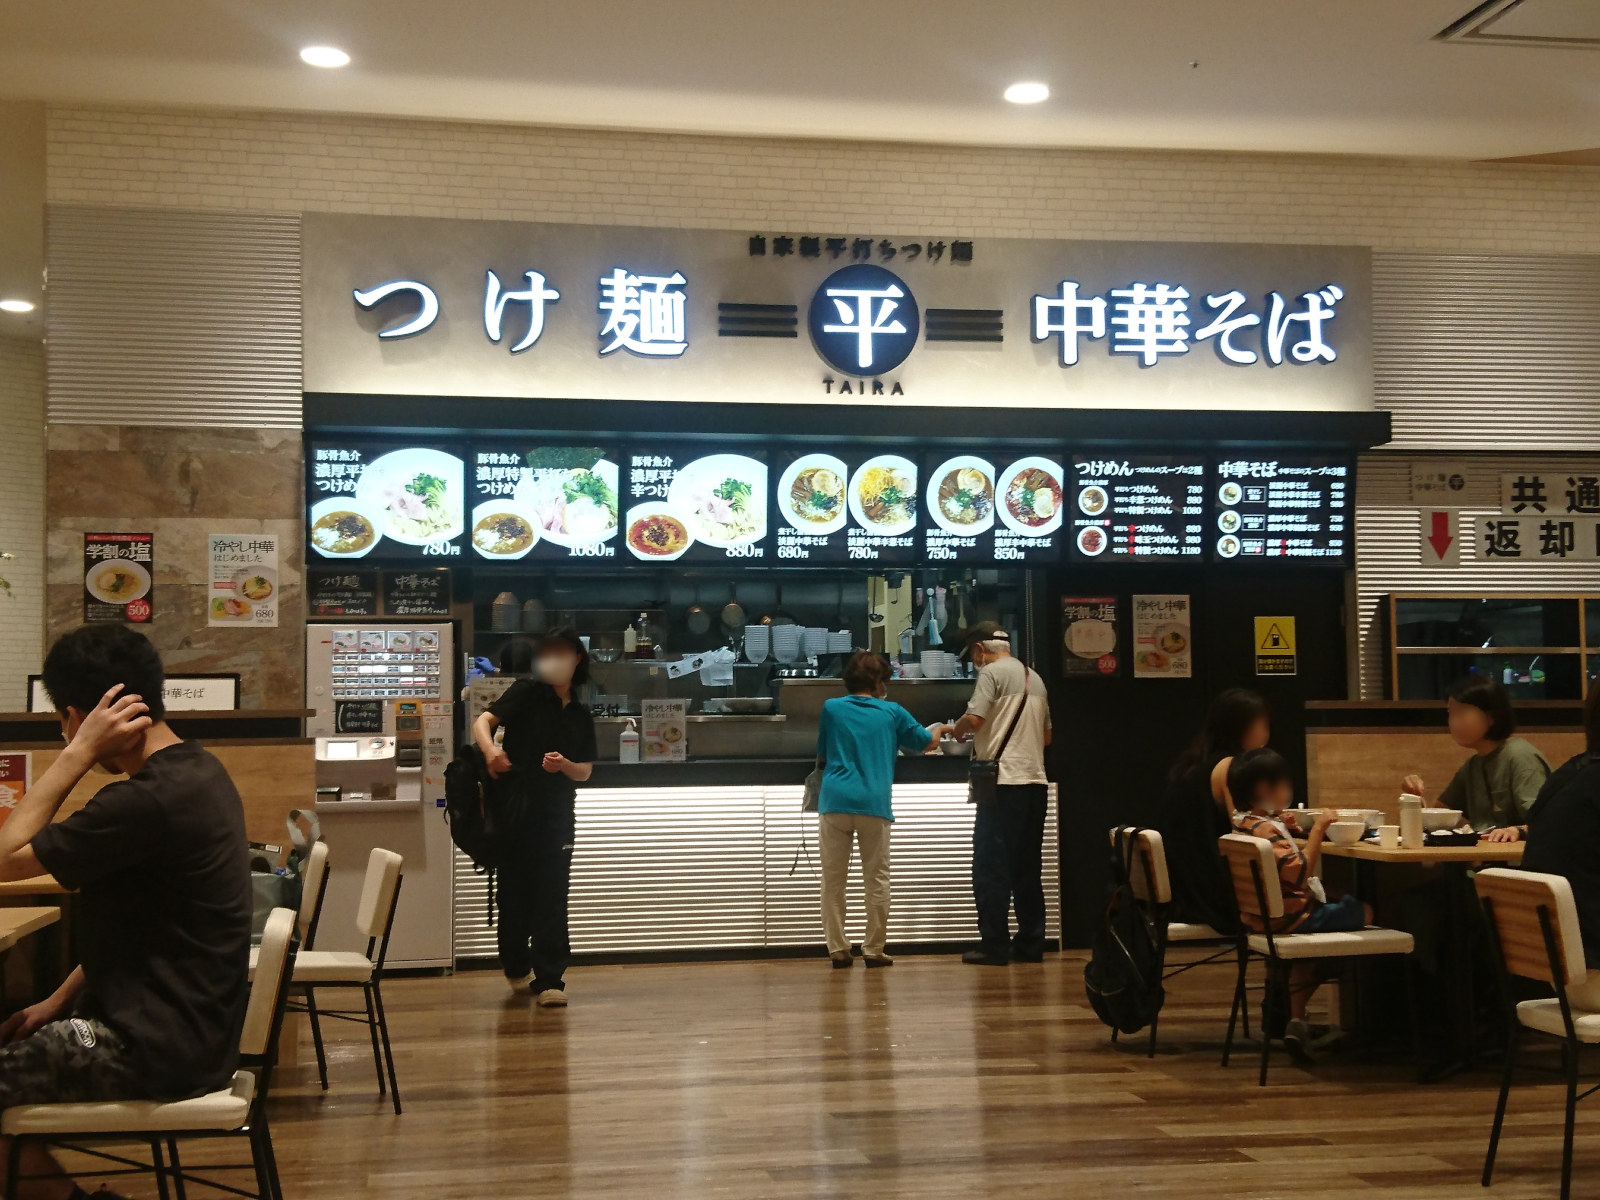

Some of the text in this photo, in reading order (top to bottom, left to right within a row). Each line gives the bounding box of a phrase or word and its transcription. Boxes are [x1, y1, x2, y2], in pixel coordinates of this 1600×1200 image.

[749, 235, 974, 262] 自家製平打ちつけ麺
[354, 267, 688, 357] つけ麺
[823, 284, 907, 367] 平
[1031, 280, 1345, 366] 中華そば
[822, 379, 905, 396] TAIRA
[316, 449, 362, 461] 豚骨魚介
[477, 453, 521, 465] 豚骨魚介
[631, 456, 673, 467] 豚骨魚介
[1074, 460, 1134, 476] つけめん
[1218, 461, 1278, 478] 中華そば
[1510, 476, 1600, 513] 共通
[1485, 520, 1600, 558] 返却
[86, 542, 152, 562] 学割の塩
[213, 540, 275, 554] 冷やし中華
[421, 540, 461, 555] 780円
[568, 542, 615, 556] 1080円
[725, 543, 764, 557] 880円
[777, 546, 809, 559] 680円
[848, 546, 879, 559] 780円
[926, 547, 957, 560] 750円
[993, 547, 1025, 560] 850円
[214, 554, 263, 562] はじめました
[128, 605, 150, 615] 500
[1064, 604, 1117, 621] 学割の塩
[1136, 600, 1187, 612] 冷やし中華
[255, 609, 274, 618] 680
[1098, 660, 1117, 669] 500
[645, 704, 683, 713] 冷やし中華
